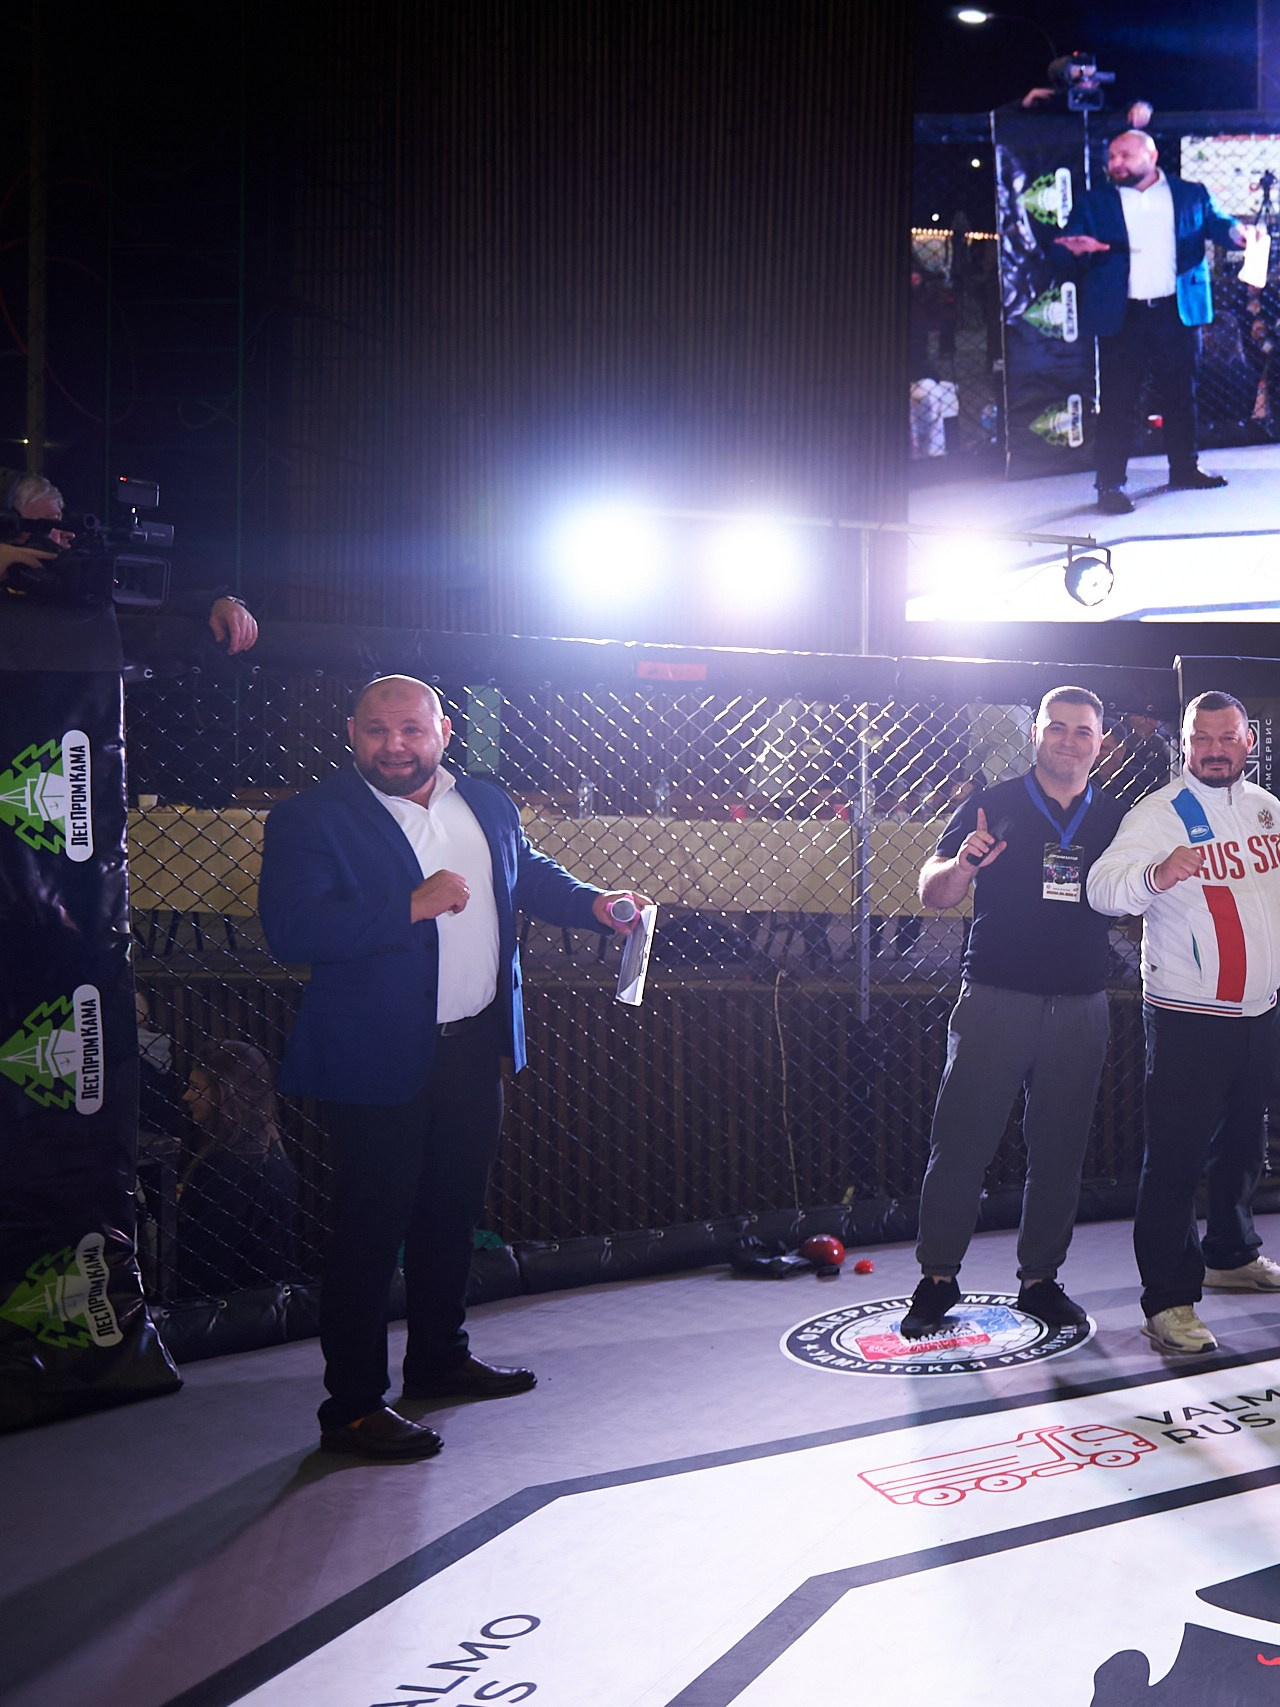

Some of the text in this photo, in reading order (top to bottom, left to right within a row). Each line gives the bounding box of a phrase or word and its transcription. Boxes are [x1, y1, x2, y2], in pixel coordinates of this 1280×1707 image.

[1189, 841, 1246, 880] RUS
[796, 1298, 913, 1342] ФЕДЕРАЦ
[810, 1347, 988, 1374] УДМУРТСКАЯ
[999, 1325, 1078, 1364] РЕСПУБЛ
[1161, 1413, 1276, 1444] RUS
